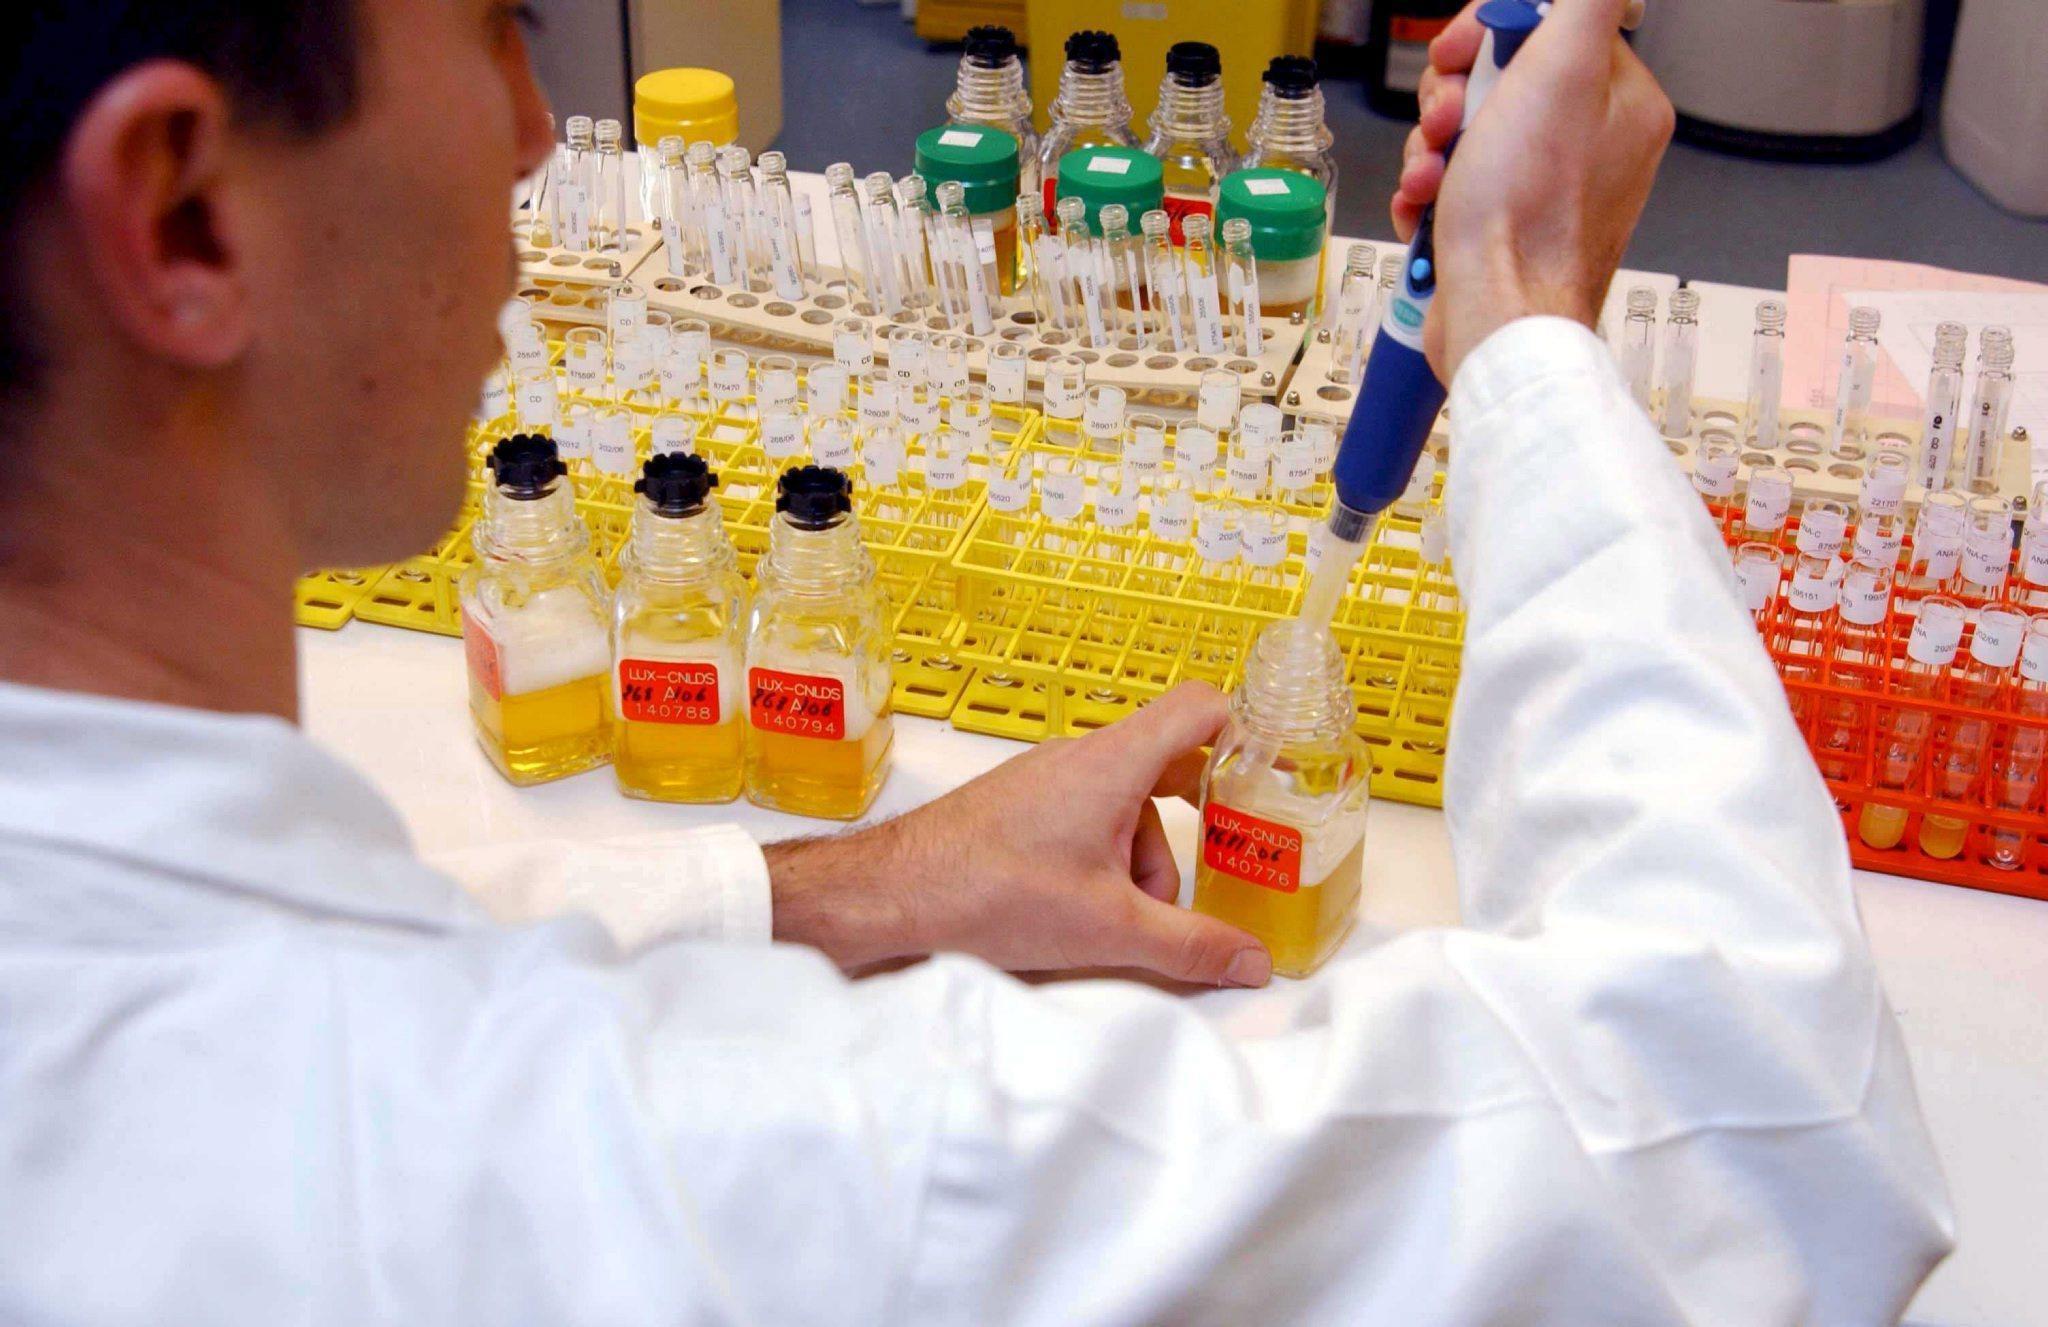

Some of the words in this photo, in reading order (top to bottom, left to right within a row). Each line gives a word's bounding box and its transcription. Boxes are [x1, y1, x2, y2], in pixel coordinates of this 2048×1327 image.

[897, 370, 911, 379] CD
[529, 396, 542, 404] CD
[628, 667, 716, 686] LUX-CNLDS
[757, 676, 841, 701] LUX-CNLDS
[636, 702, 712, 720] 140788
[763, 711, 837, 735] 140794
[1213, 813, 1300, 853] LUX-CNLDS
[1244, 842, 1260, 862] A
[1216, 851, 1290, 887] 140776
